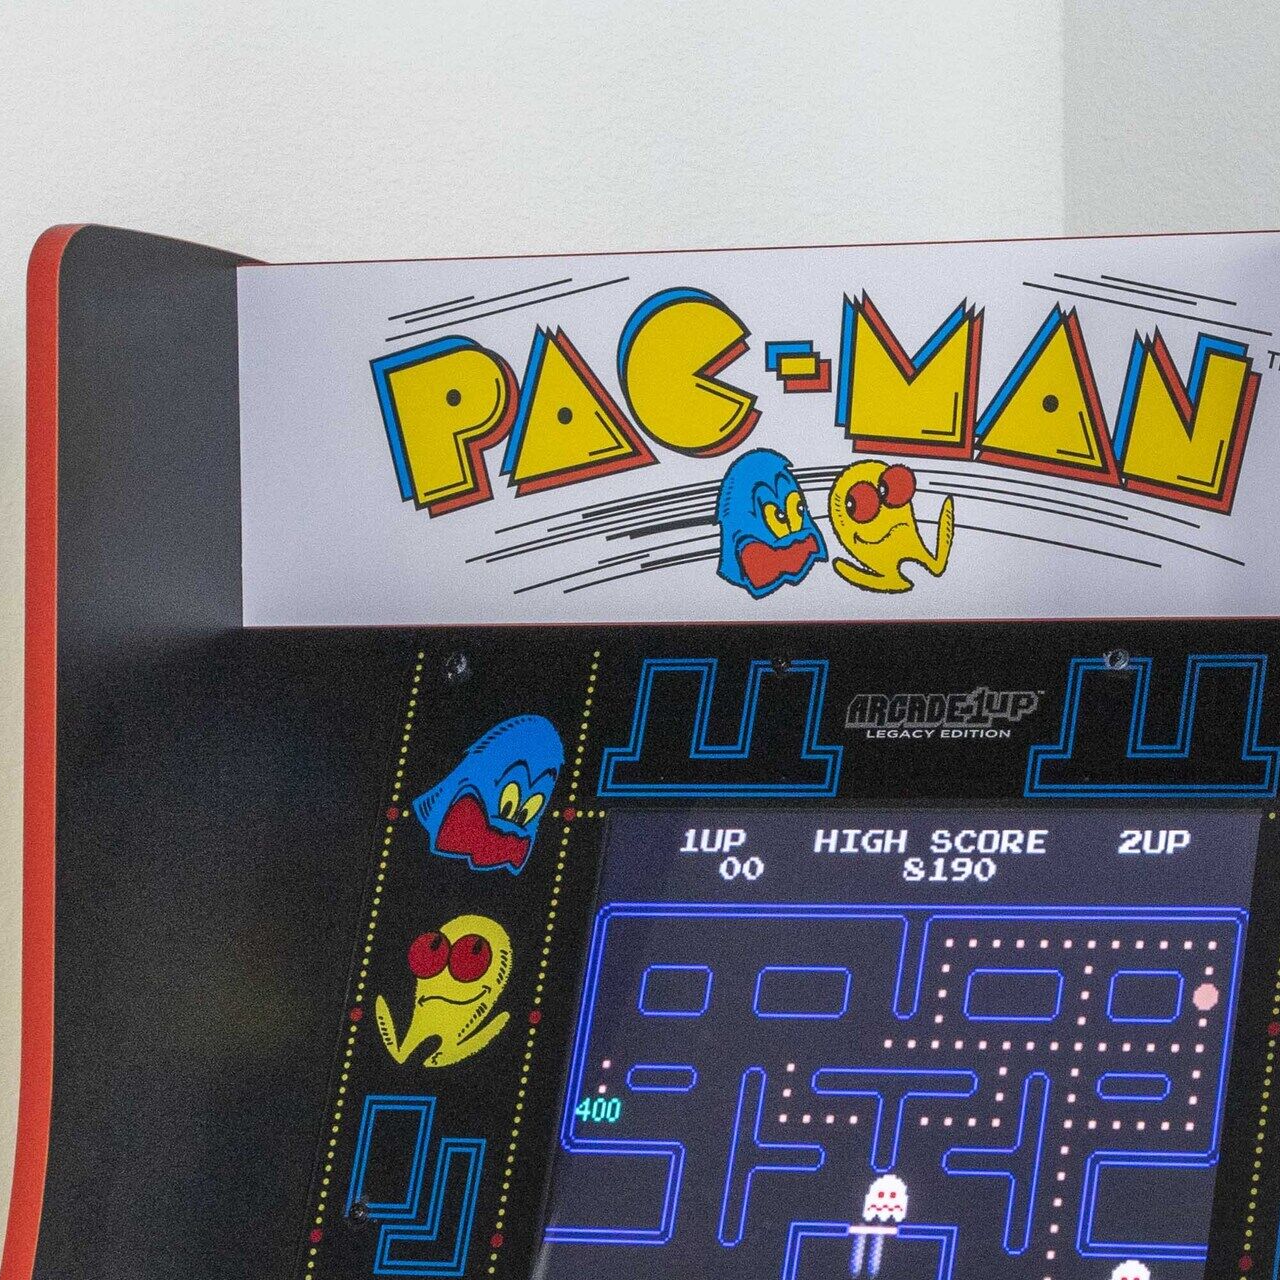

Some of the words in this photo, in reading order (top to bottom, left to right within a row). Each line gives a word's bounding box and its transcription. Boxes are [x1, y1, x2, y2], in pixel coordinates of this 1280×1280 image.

[370, 286, 1262, 518] PAC-MAN
[844, 686, 1039, 728] ARCADE1UP
[866, 729, 935, 739] LEGACY
[940, 729, 1011, 739] EDITION
[679, 828, 747, 853] 1UP
[813, 828, 908, 854] HIGH
[930, 829, 1049, 854] SCORE
[1118, 830, 1191, 855] 2UP
[719, 856, 765, 881] 00
[902, 857, 997, 882] 8190
[575, 1097, 621, 1122] 400
